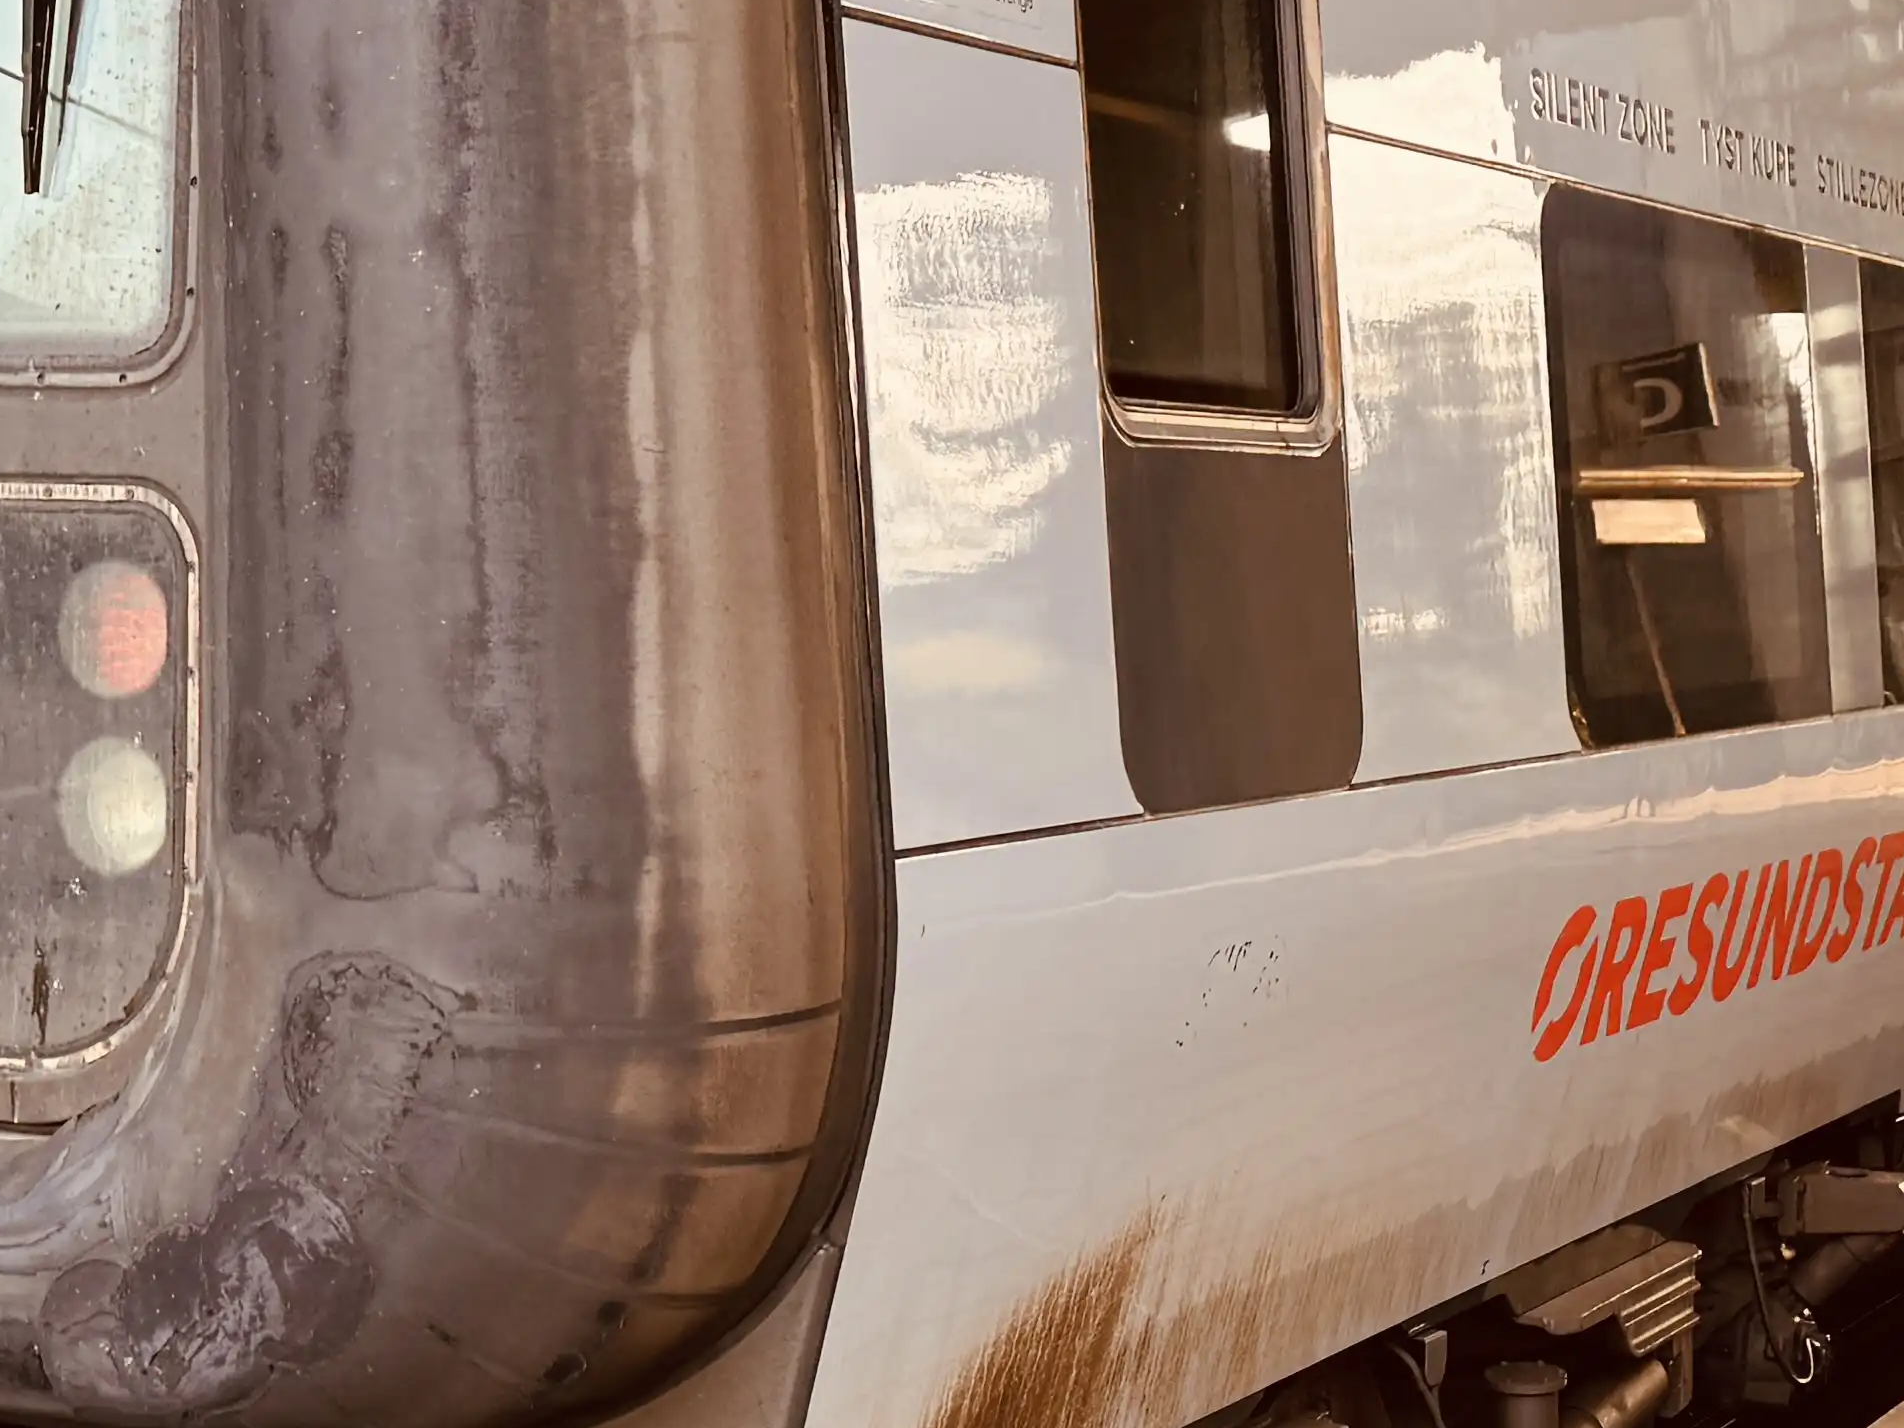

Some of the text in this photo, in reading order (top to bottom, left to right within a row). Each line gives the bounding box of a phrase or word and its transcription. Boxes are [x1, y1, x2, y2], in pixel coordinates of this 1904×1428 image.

[1529, 67, 1609, 136] SILENT
[1615, 92, 1675, 154] ZONE
[1698, 118, 1744, 174] TYST
